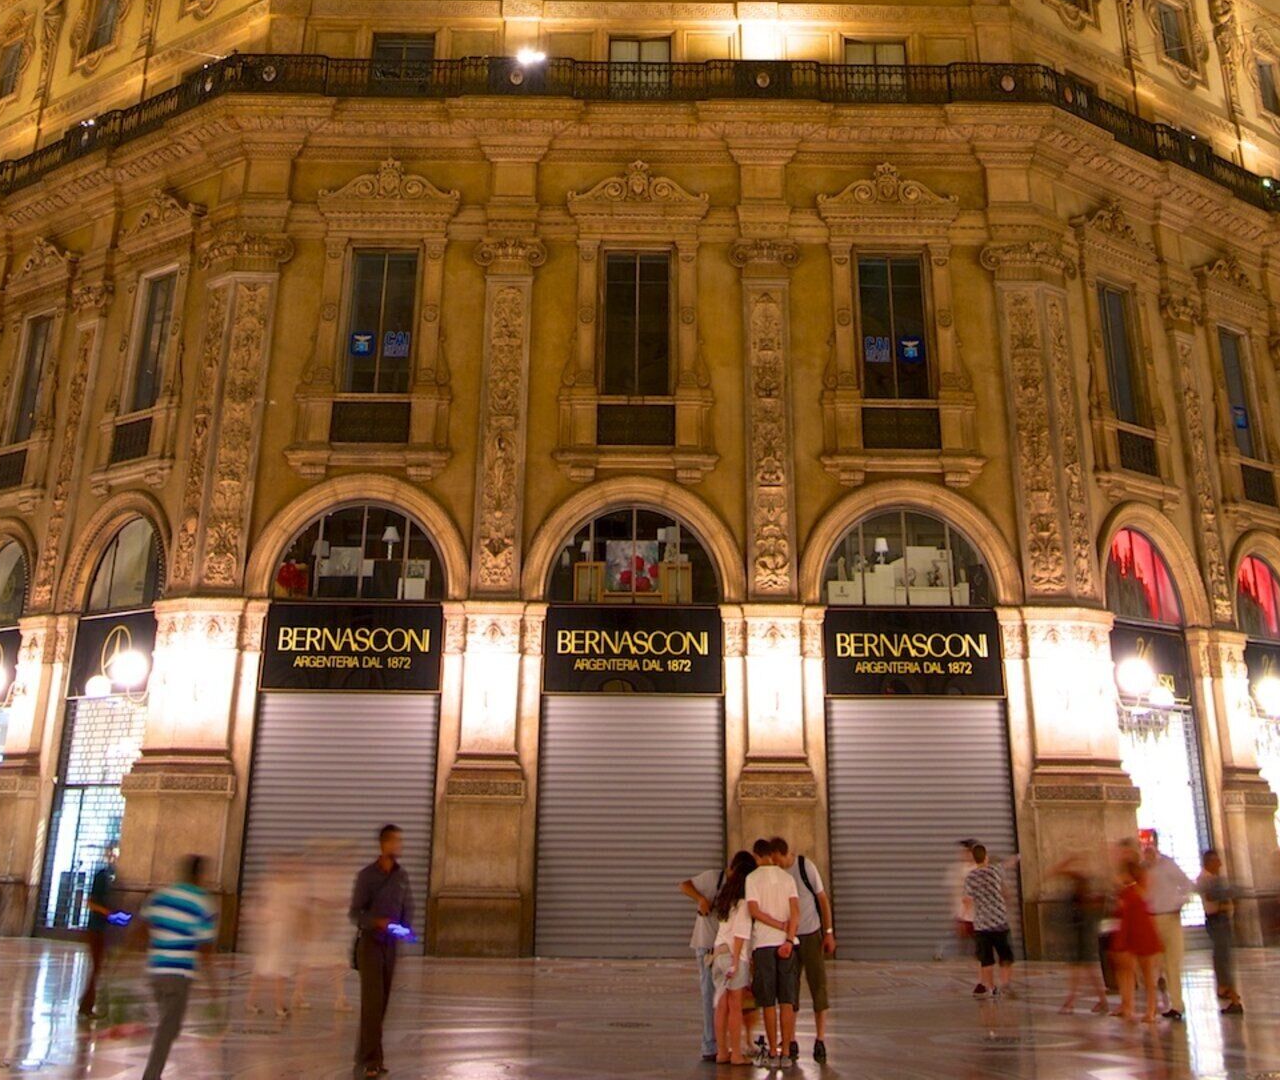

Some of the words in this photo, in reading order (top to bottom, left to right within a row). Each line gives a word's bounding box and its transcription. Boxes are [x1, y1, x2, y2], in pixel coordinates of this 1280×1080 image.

[277, 627, 431, 652] BERNASCONI
[556, 630, 709, 655] BERNASCONI
[836, 633, 989, 658] BERNASCONI
[293, 655, 359, 668] ARGENTERIA
[362, 657, 383, 669] DAL
[387, 657, 411, 669] 1872
[574, 658, 640, 671] ARGENTERIA
[642, 659, 663, 671] DAL
[667, 660, 692, 672] 1872
[855, 661, 921, 674] ARGENTERIA
[923, 662, 945, 674] DAL
[948, 662, 973, 675] 1872
